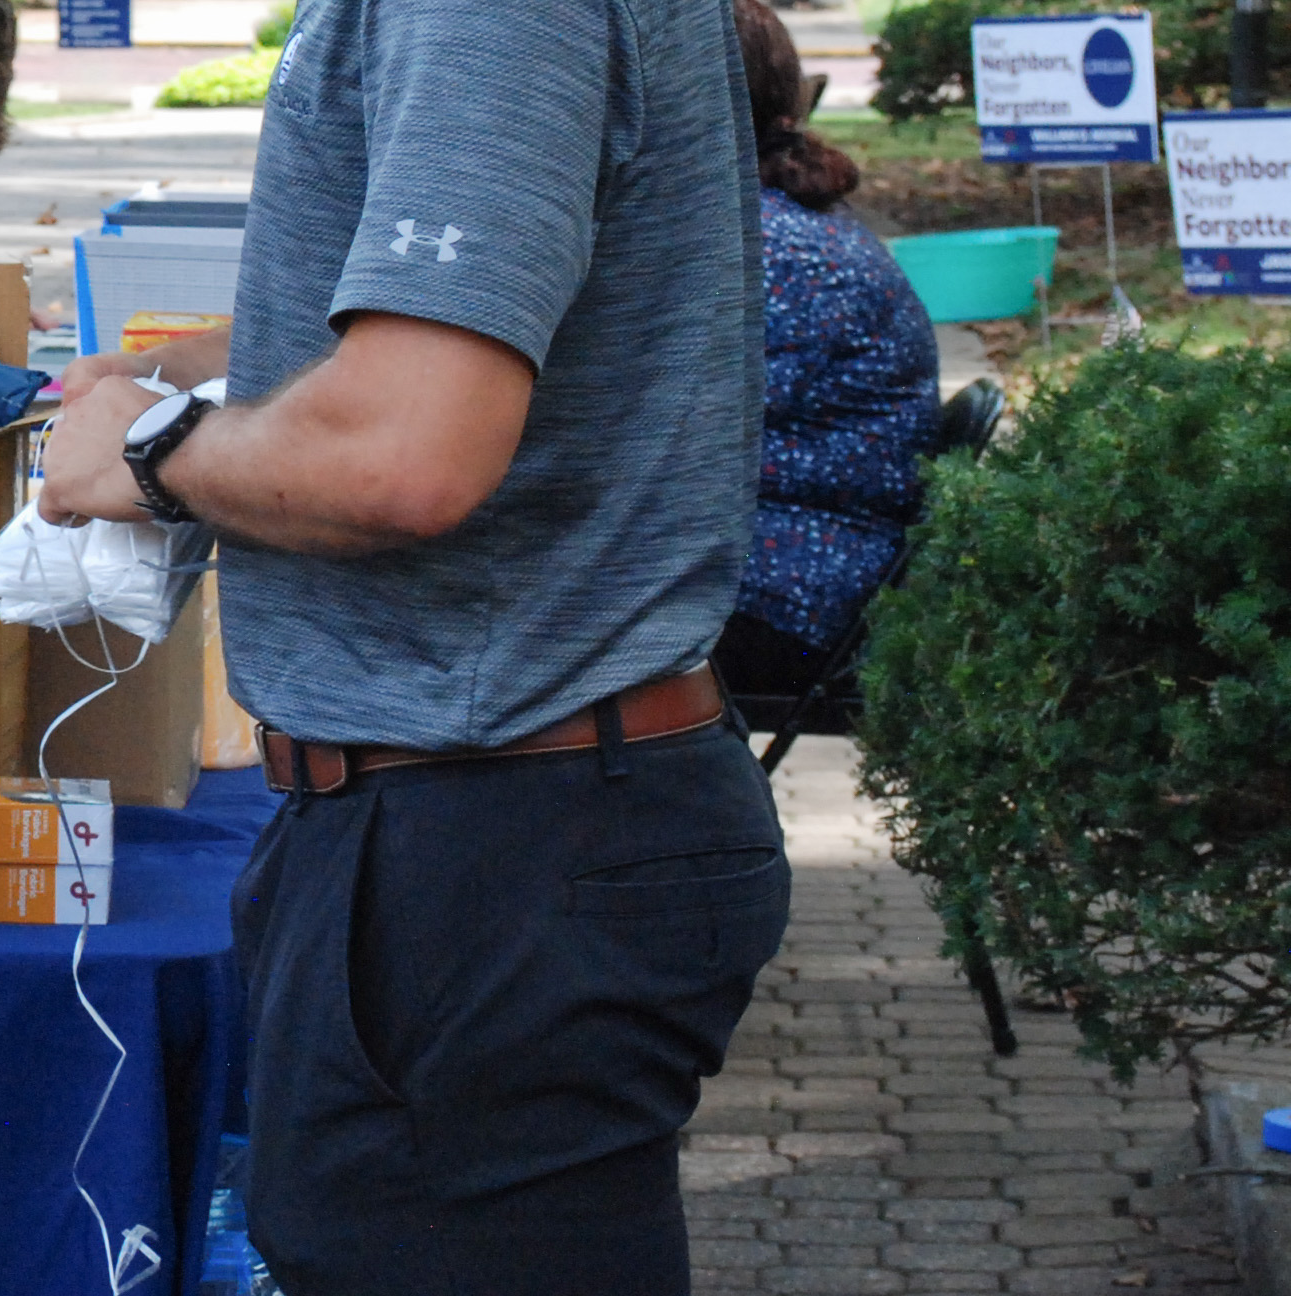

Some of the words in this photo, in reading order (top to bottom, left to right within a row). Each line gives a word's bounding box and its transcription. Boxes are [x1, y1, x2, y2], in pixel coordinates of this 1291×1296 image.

[1172, 130, 1210, 154] Our
[20, 809, 32, 859] Bandages
[32, 809, 42, 840] Fabric
